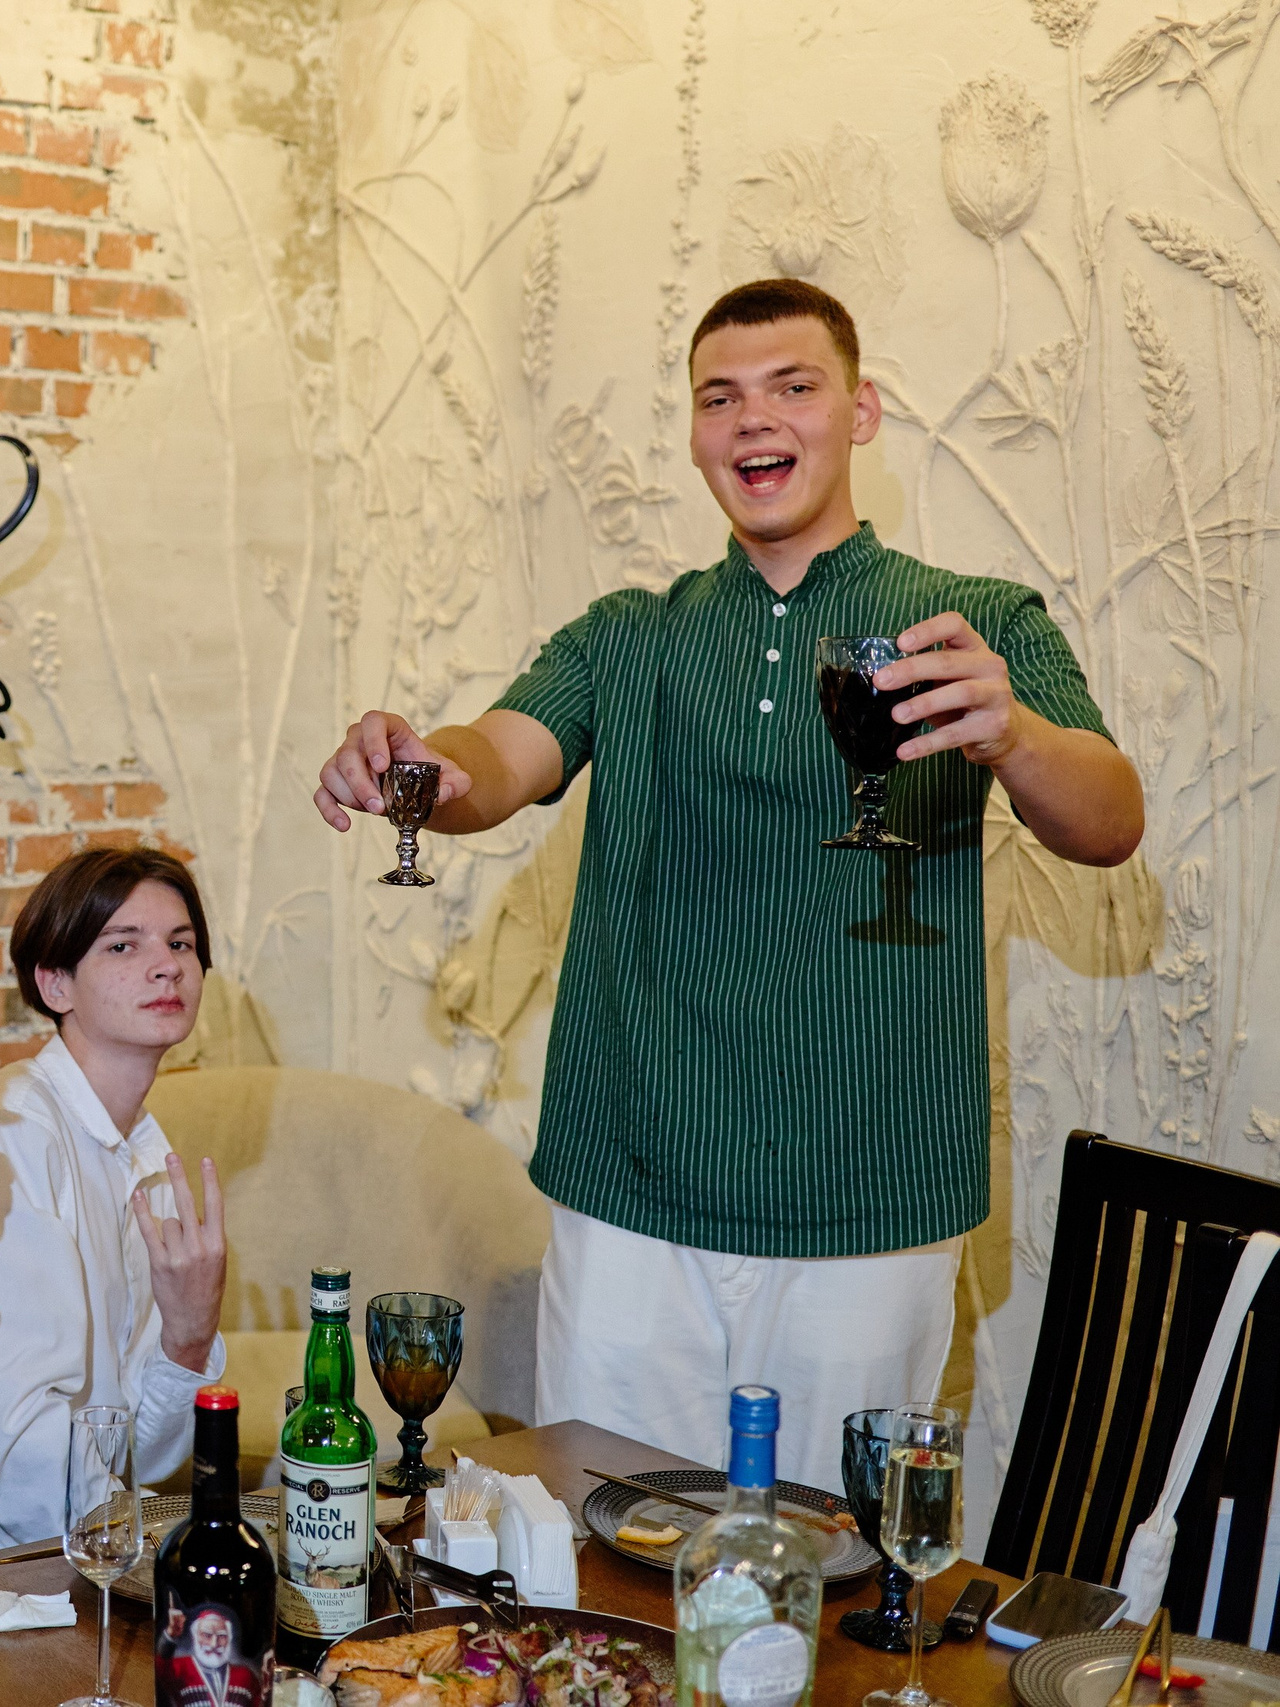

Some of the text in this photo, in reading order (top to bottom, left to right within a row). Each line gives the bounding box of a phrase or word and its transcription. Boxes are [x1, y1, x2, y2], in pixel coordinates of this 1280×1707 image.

[332, 1486, 361, 1494] RESERVE
[297, 1504, 340, 1522] GLEN
[286, 1512, 355, 1540] RANOCH
[291, 1592, 345, 1607] SCOTCH WHISKY
[312, 1590, 338, 1600] SINGLE
[340, 1590, 357, 1598] MALT
